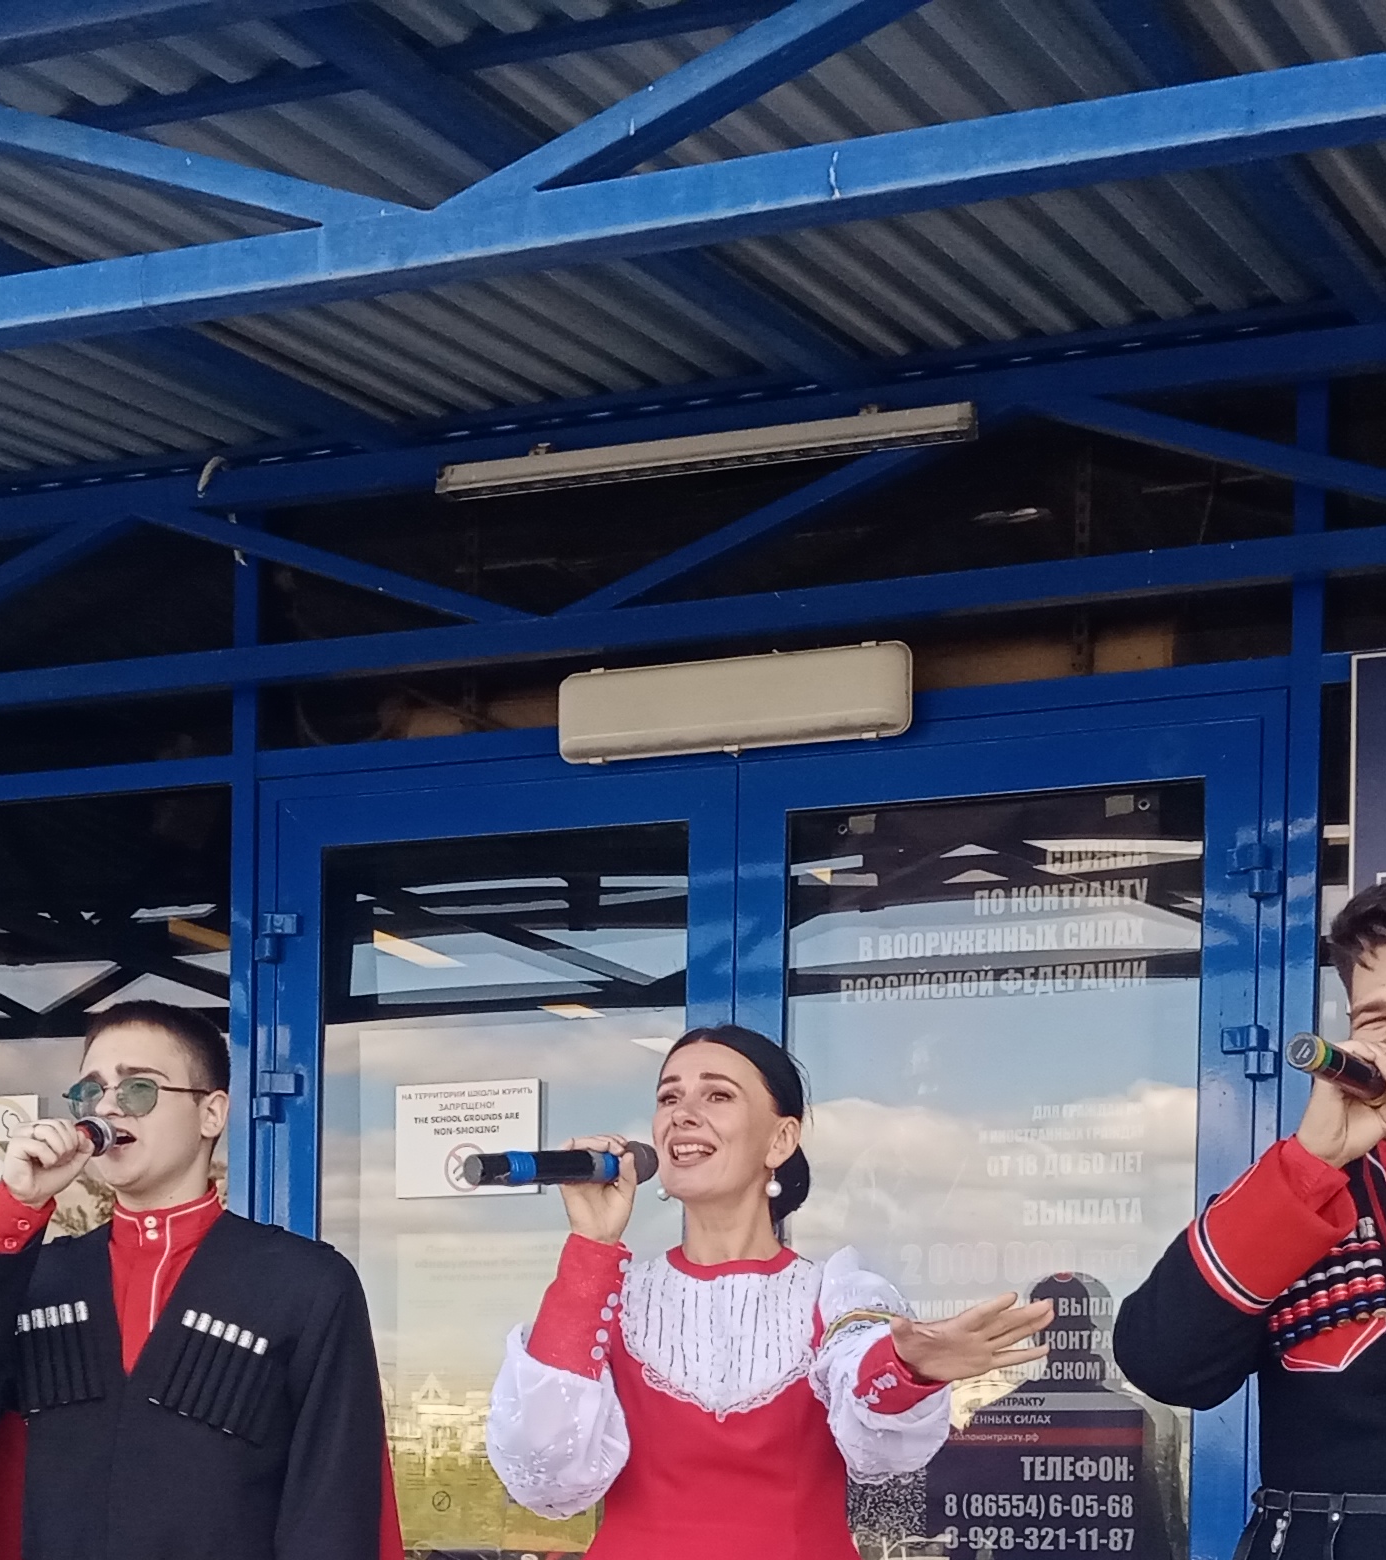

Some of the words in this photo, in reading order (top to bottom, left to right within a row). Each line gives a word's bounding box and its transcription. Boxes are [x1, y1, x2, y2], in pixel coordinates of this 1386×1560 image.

[974, 888, 1005, 916] ПО
[1011, 877, 1149, 914] КОНТРАКТУ
[858, 936, 873, 962] В
[879, 923, 1059, 960] ВООРУЖЕННЫХ
[1064, 917, 1145, 949] СИЛАХ
[840, 965, 994, 1005] РОССИЙСКОЙ
[999, 960, 1148, 997] ФЕДЕРАЦИИ
[415, 1090, 465, 1100] ТЕРРИТОРИИ
[468, 1088, 500, 1097] ШКОЛЫ
[502, 1086, 533, 1095] КУРИТЬ
[414, 1116, 429, 1124] THE
[430, 1114, 462, 1124] SCHOOL
[463, 1112, 503, 1122] GROUNDS
[504, 1112, 520, 1120] ARE
[438, 1101, 495, 1111] ЗАПРЕЩЕНО!
[433, 1125, 500, 1135] NON-SMOKING!
[995, 1126, 1083, 1144] ИНОСТРАННЫХ
[986, 1154, 1012, 1178] ОТ
[1015, 1155, 1038, 1177] 18
[1042, 1152, 1073, 1178] ДО
[1077, 1152, 1105, 1175] 60
[1109, 1151, 1145, 1175] ЛЕТ
[1022, 1197, 1144, 1226] ВЫПЛАТА
[1014, 1414, 1052, 1425] СИЛАХ
[1020, 1455, 1135, 1482] ТЕЛЕФОН:
[944, 1493, 958, 1517] 8
